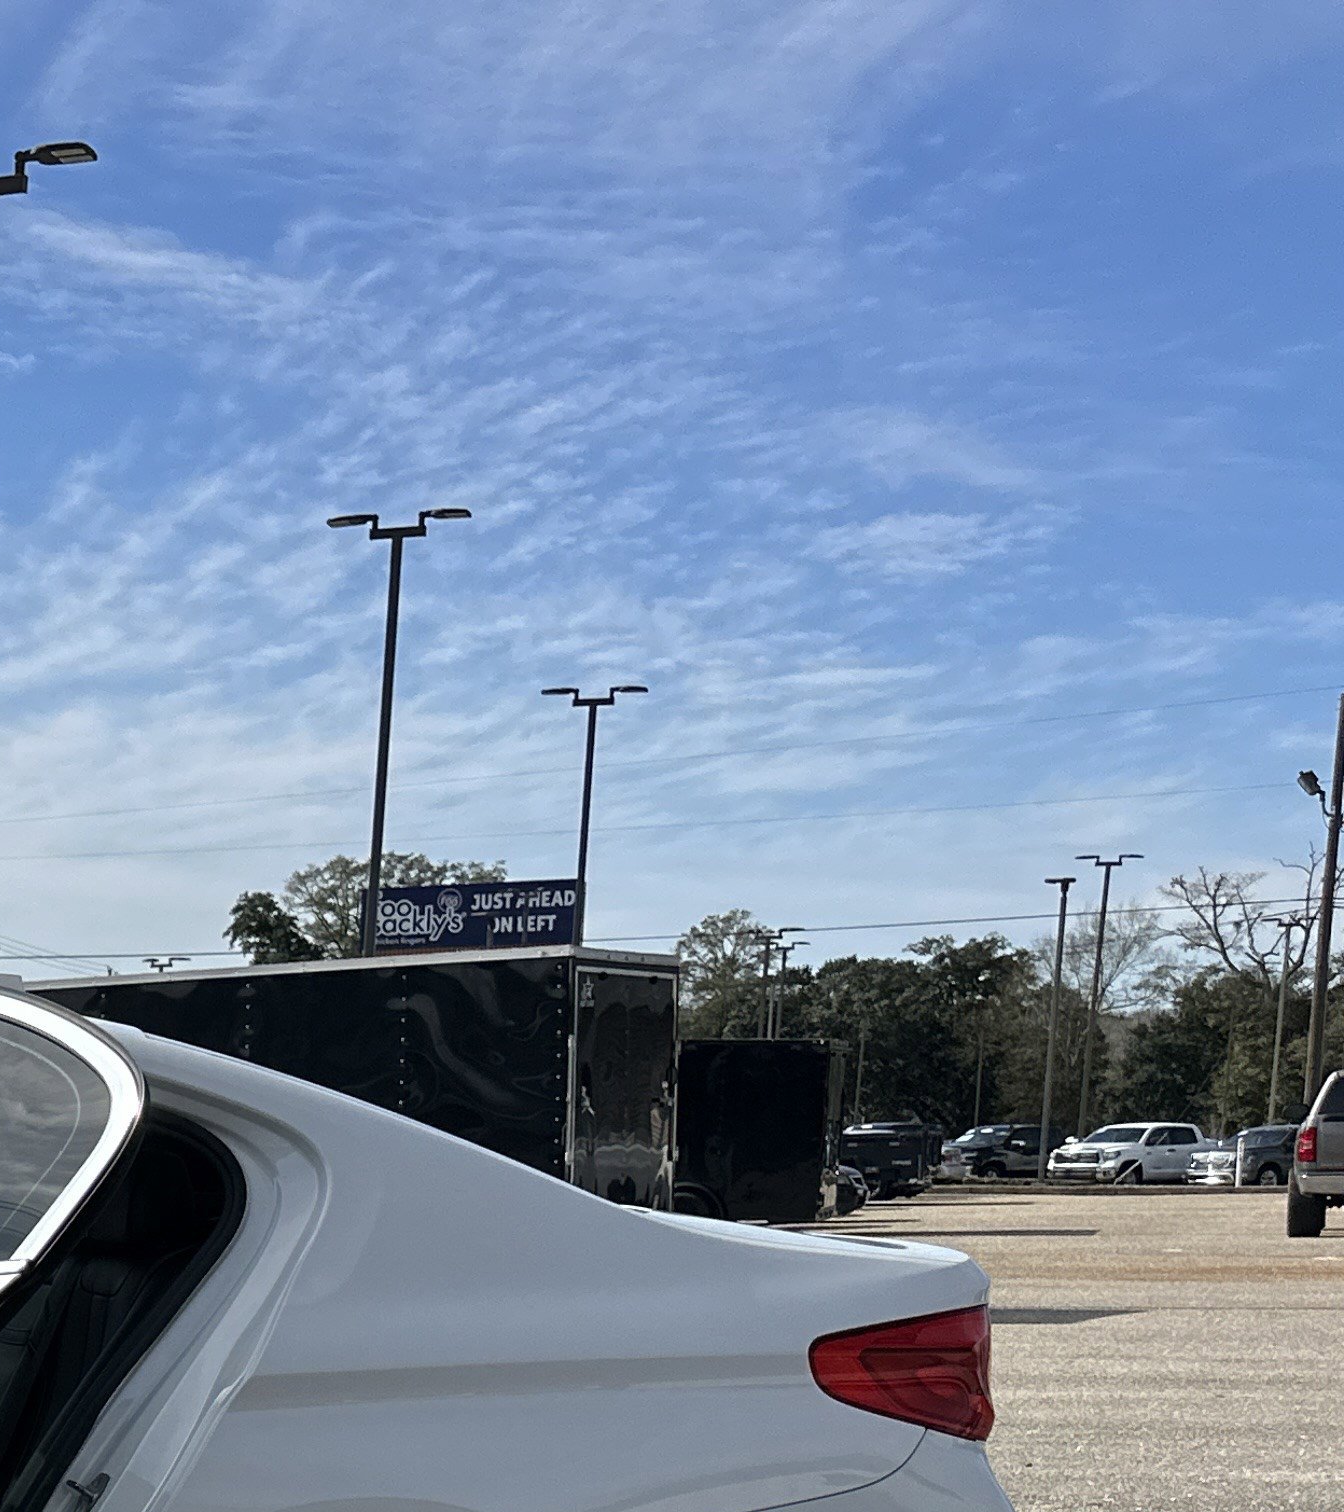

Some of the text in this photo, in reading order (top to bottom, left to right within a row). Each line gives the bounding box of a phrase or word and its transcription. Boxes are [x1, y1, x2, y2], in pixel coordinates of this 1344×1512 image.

[470, 889, 577, 911] JUST AHEAD
[491, 914, 557, 934] ON LEFT
